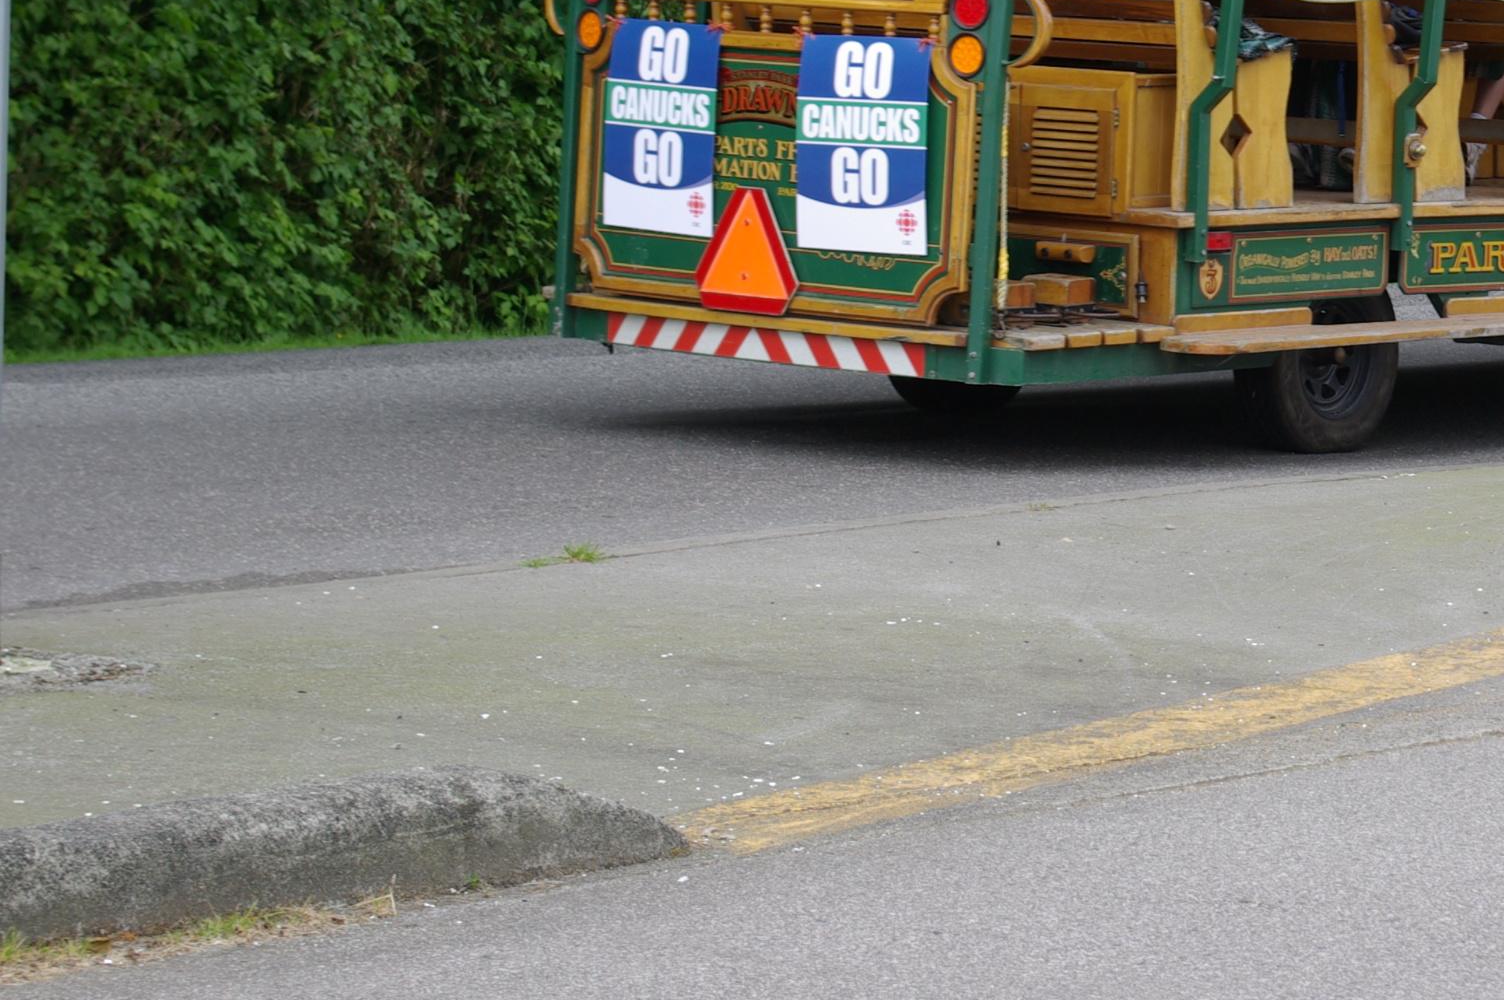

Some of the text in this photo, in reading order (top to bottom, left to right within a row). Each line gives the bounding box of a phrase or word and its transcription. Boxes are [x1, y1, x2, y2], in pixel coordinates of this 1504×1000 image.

[638, 25, 690, 84] GO
[833, 40, 895, 99] GO
[611, 85, 711, 128] CANUCKS
[802, 103, 921, 143] CANUCKS
[633, 128, 683, 188] GO
[830, 146, 889, 206] GO
